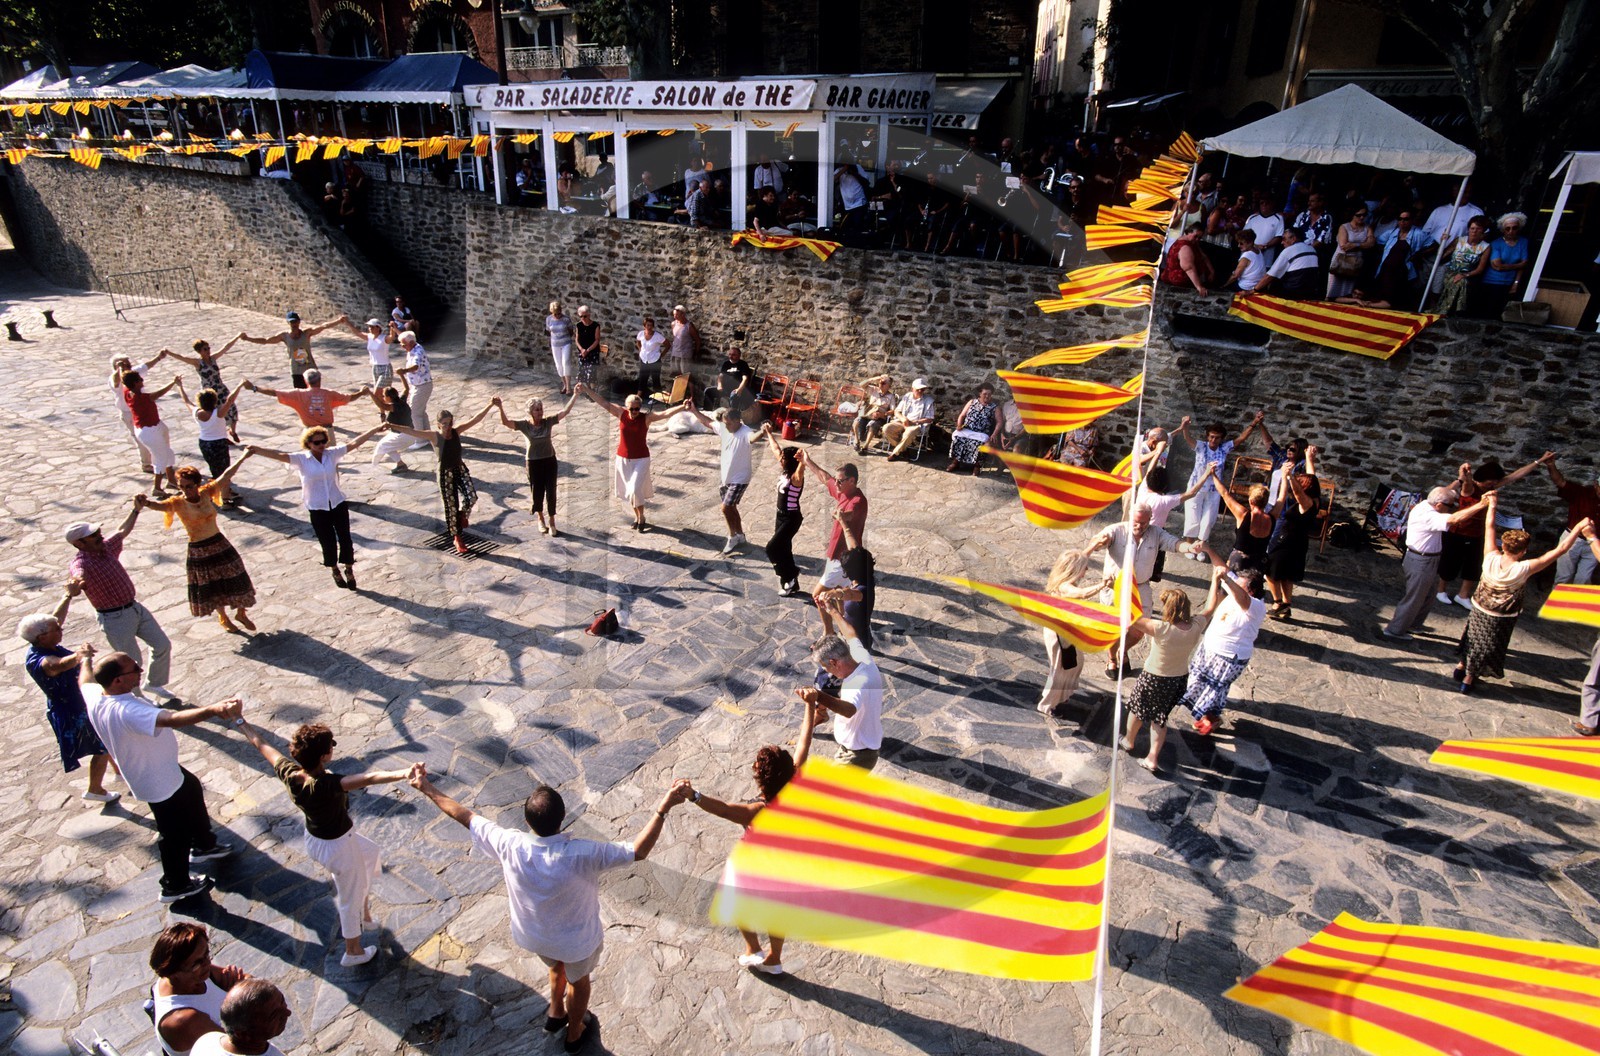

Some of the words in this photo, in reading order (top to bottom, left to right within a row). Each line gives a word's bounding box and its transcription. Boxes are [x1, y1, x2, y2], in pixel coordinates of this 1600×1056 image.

[333, 0, 376, 27] RESTAURANT
[494, 88, 525, 107] BAR
[541, 85, 634, 106] SALADERIE
[652, 85, 716, 106] SALON
[722, 85, 745, 106] de
[755, 85, 795, 106] THE
[827, 85, 862, 107] BAR
[868, 88, 931, 110] GLACIER
